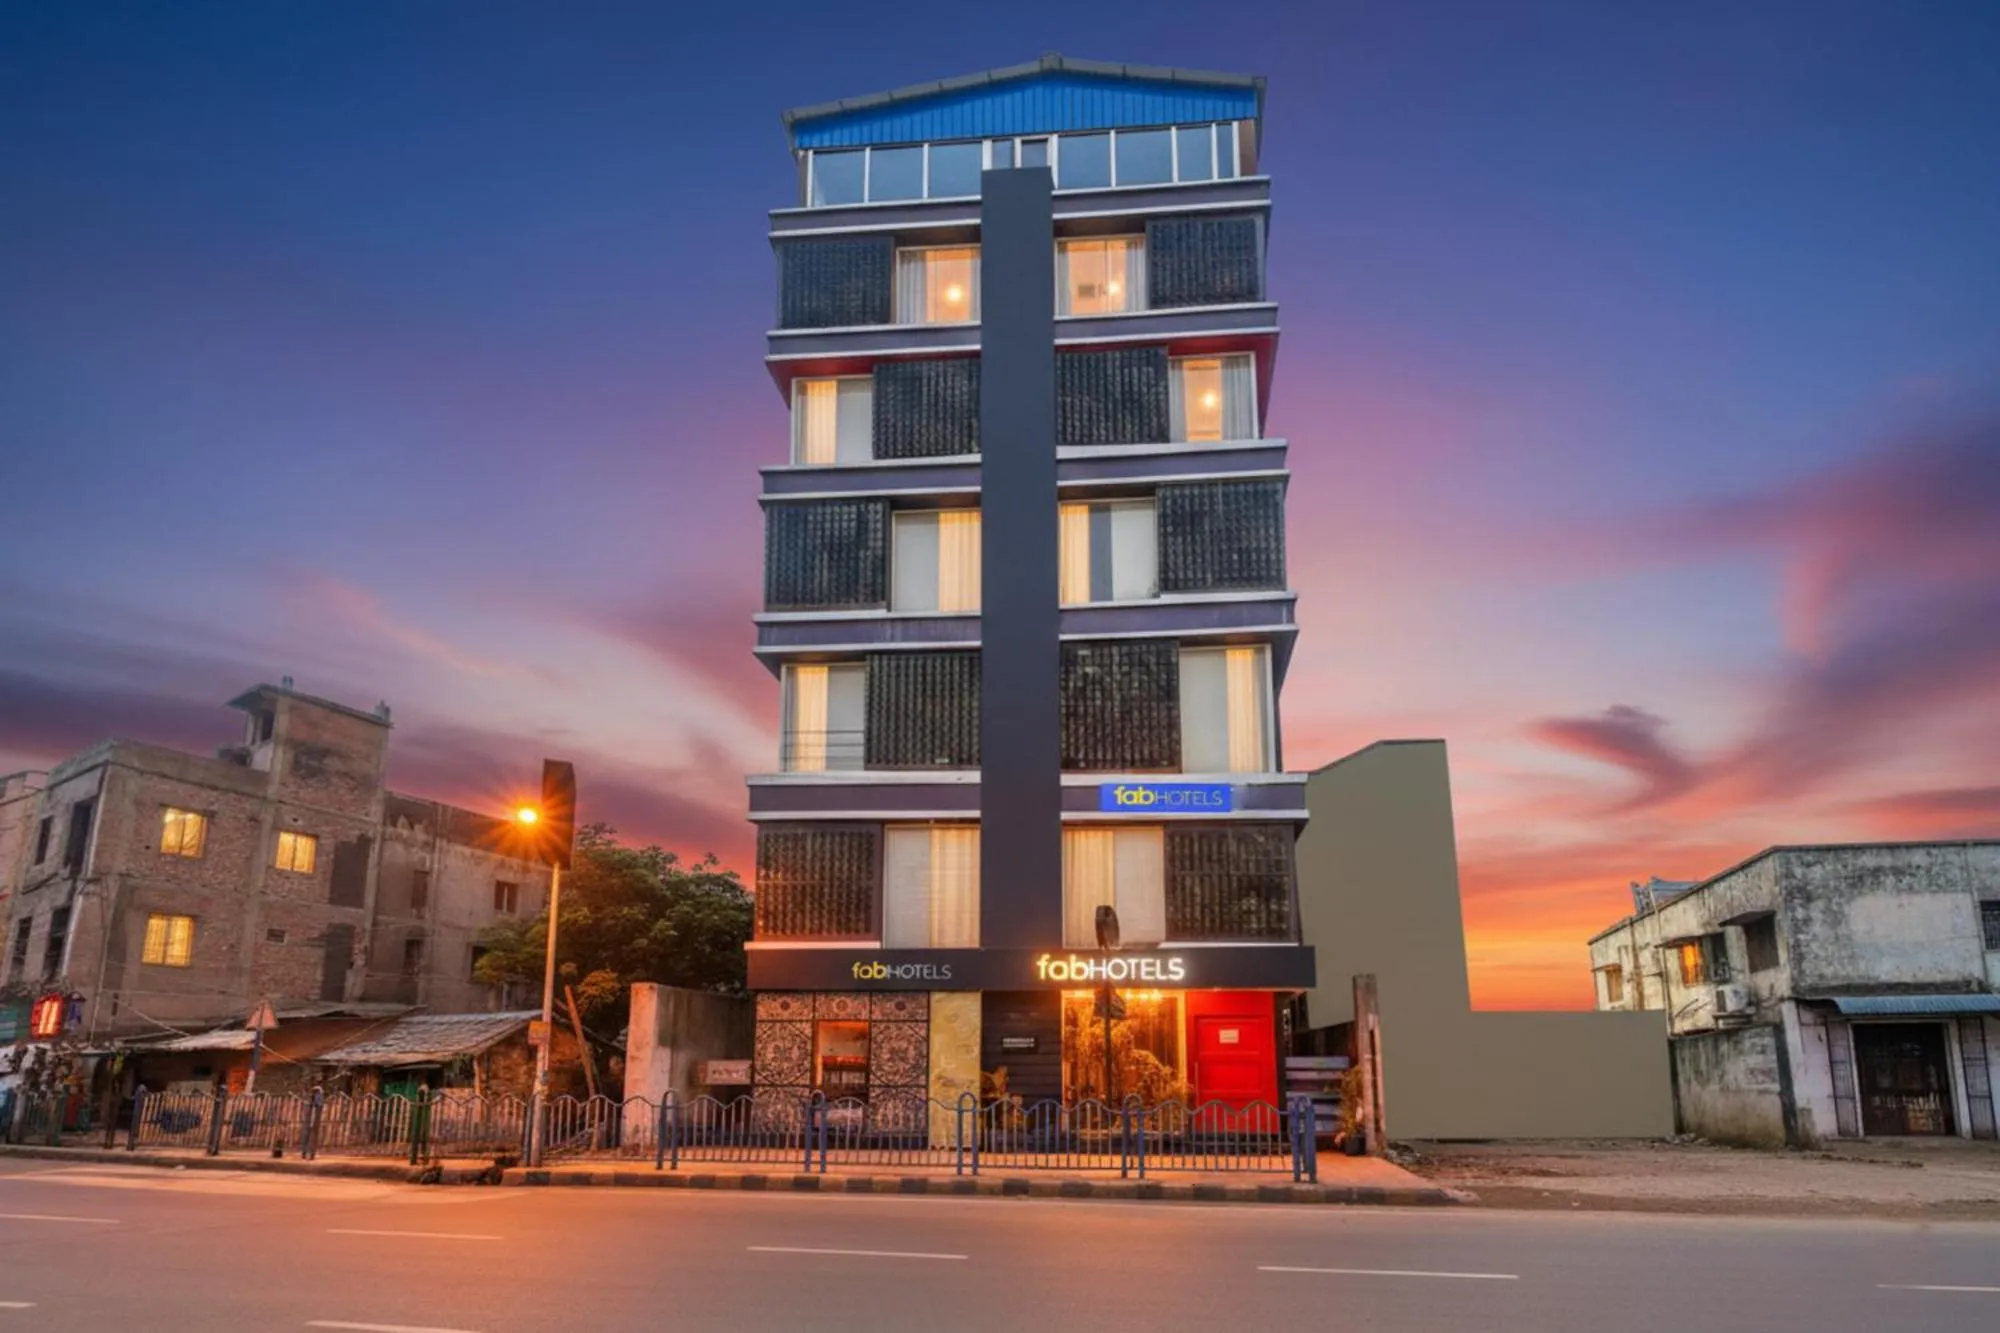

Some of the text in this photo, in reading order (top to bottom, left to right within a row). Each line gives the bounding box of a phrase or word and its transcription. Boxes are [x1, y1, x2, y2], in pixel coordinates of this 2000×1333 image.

[1114, 786, 1222, 805] fabHOTELS
[851, 961, 951, 980] fabHOTELS
[1036, 953, 1185, 981] fabHOTELS
